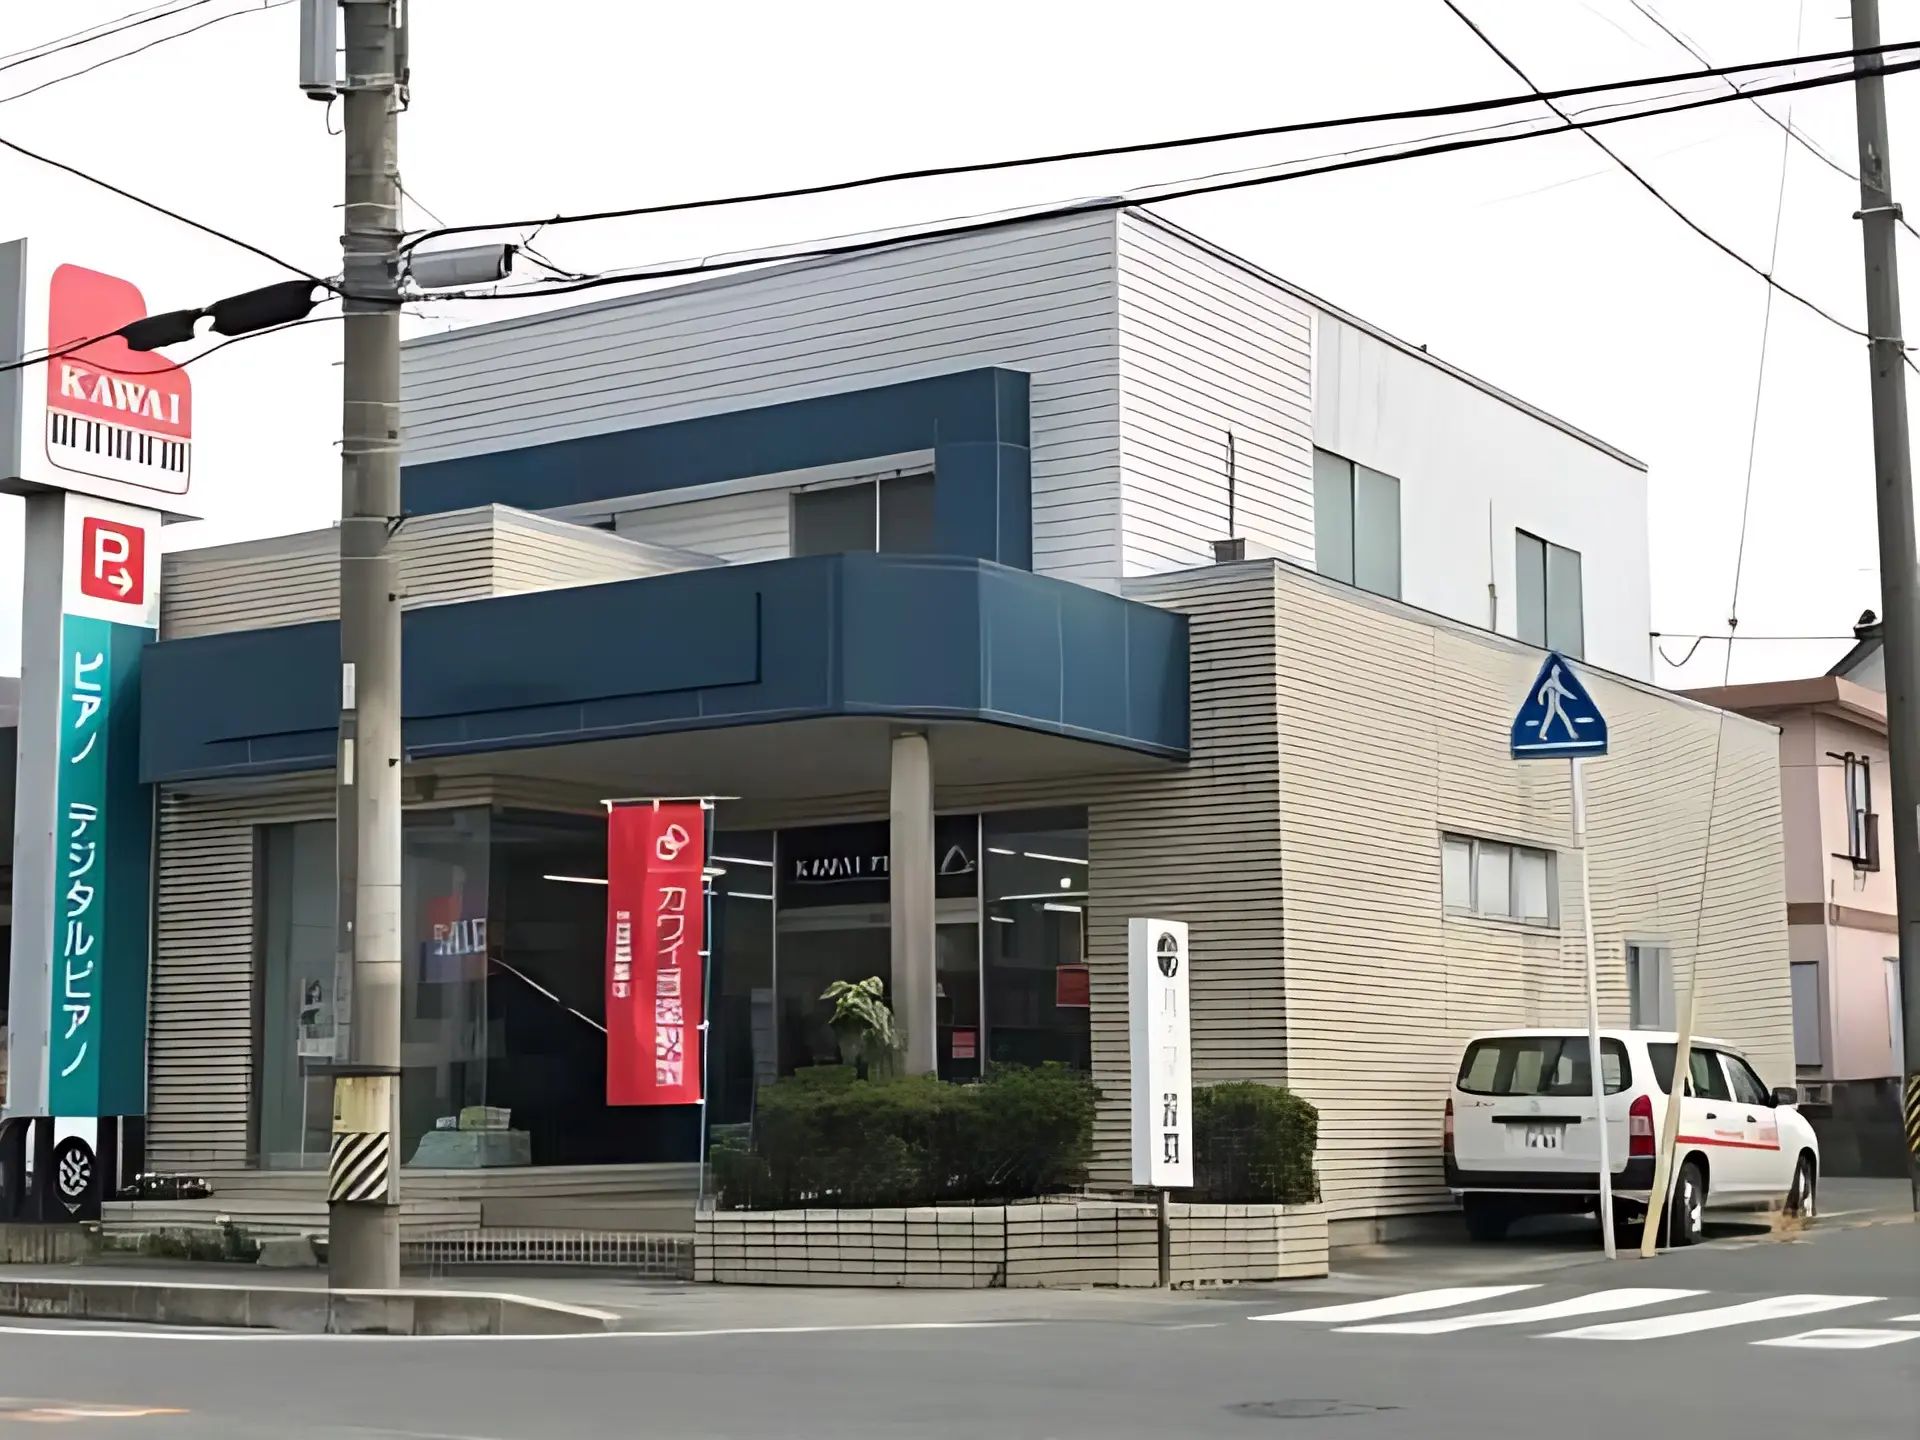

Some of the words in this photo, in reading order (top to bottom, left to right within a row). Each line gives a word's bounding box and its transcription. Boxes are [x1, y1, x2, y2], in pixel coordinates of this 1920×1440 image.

[60, 364, 180, 425] KAWAI
[94, 528, 130, 579] P
[71, 651, 104, 764] ピアノ
